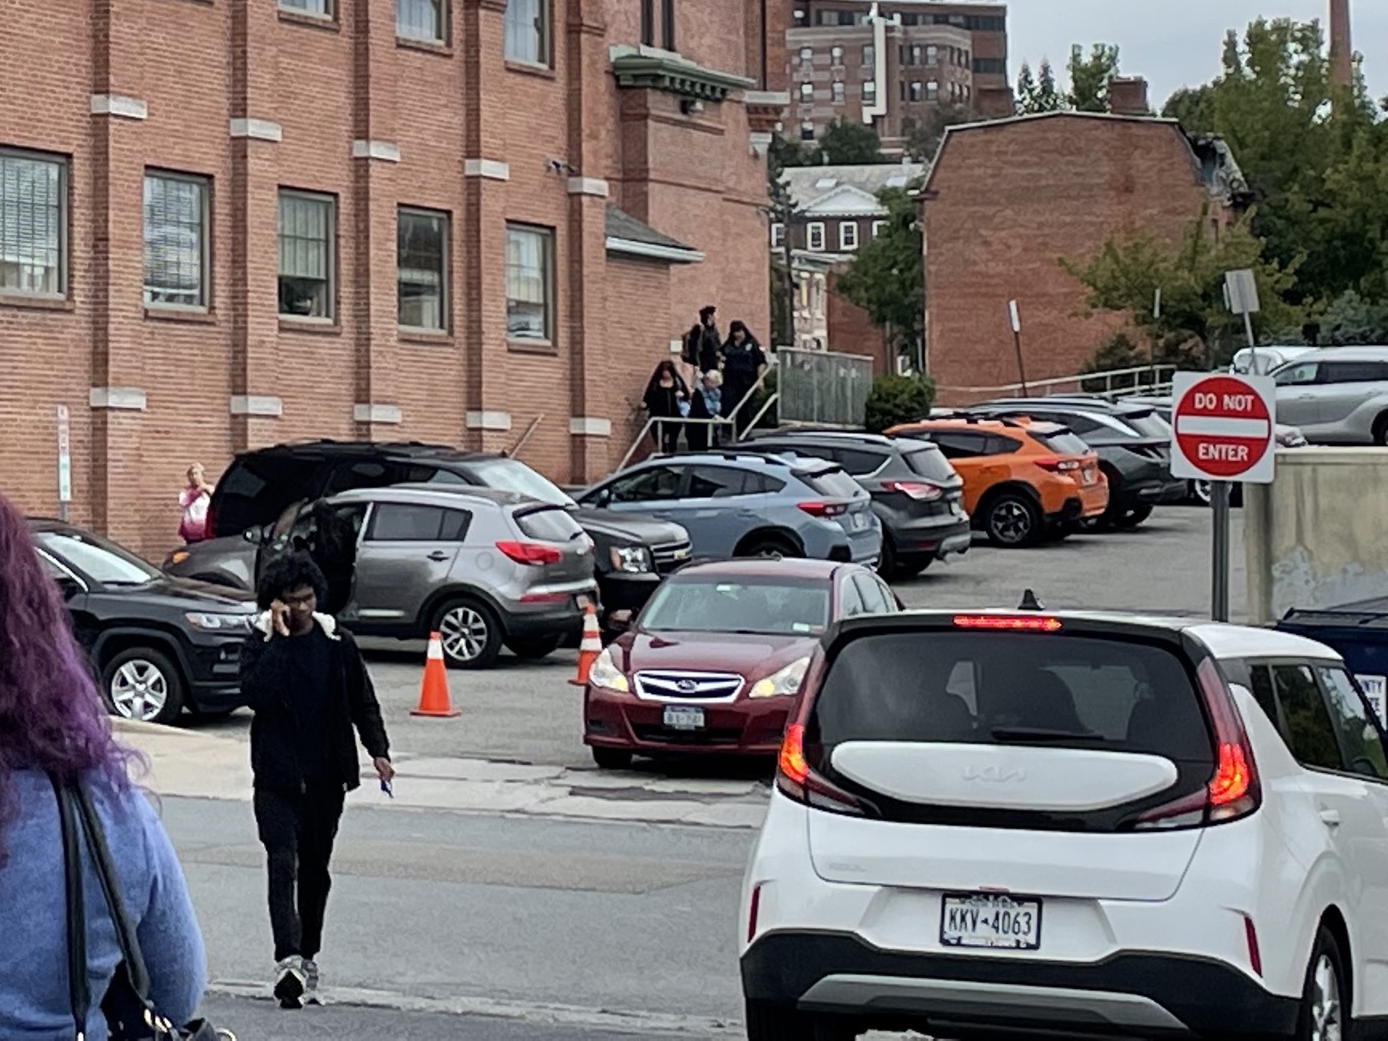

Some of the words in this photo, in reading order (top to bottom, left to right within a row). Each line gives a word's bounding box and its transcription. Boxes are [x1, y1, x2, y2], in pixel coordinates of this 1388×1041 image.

[1194, 393, 1217, 409] DO
[1223, 394, 1255, 411] NOT
[1198, 443, 1249, 461] ENTER
